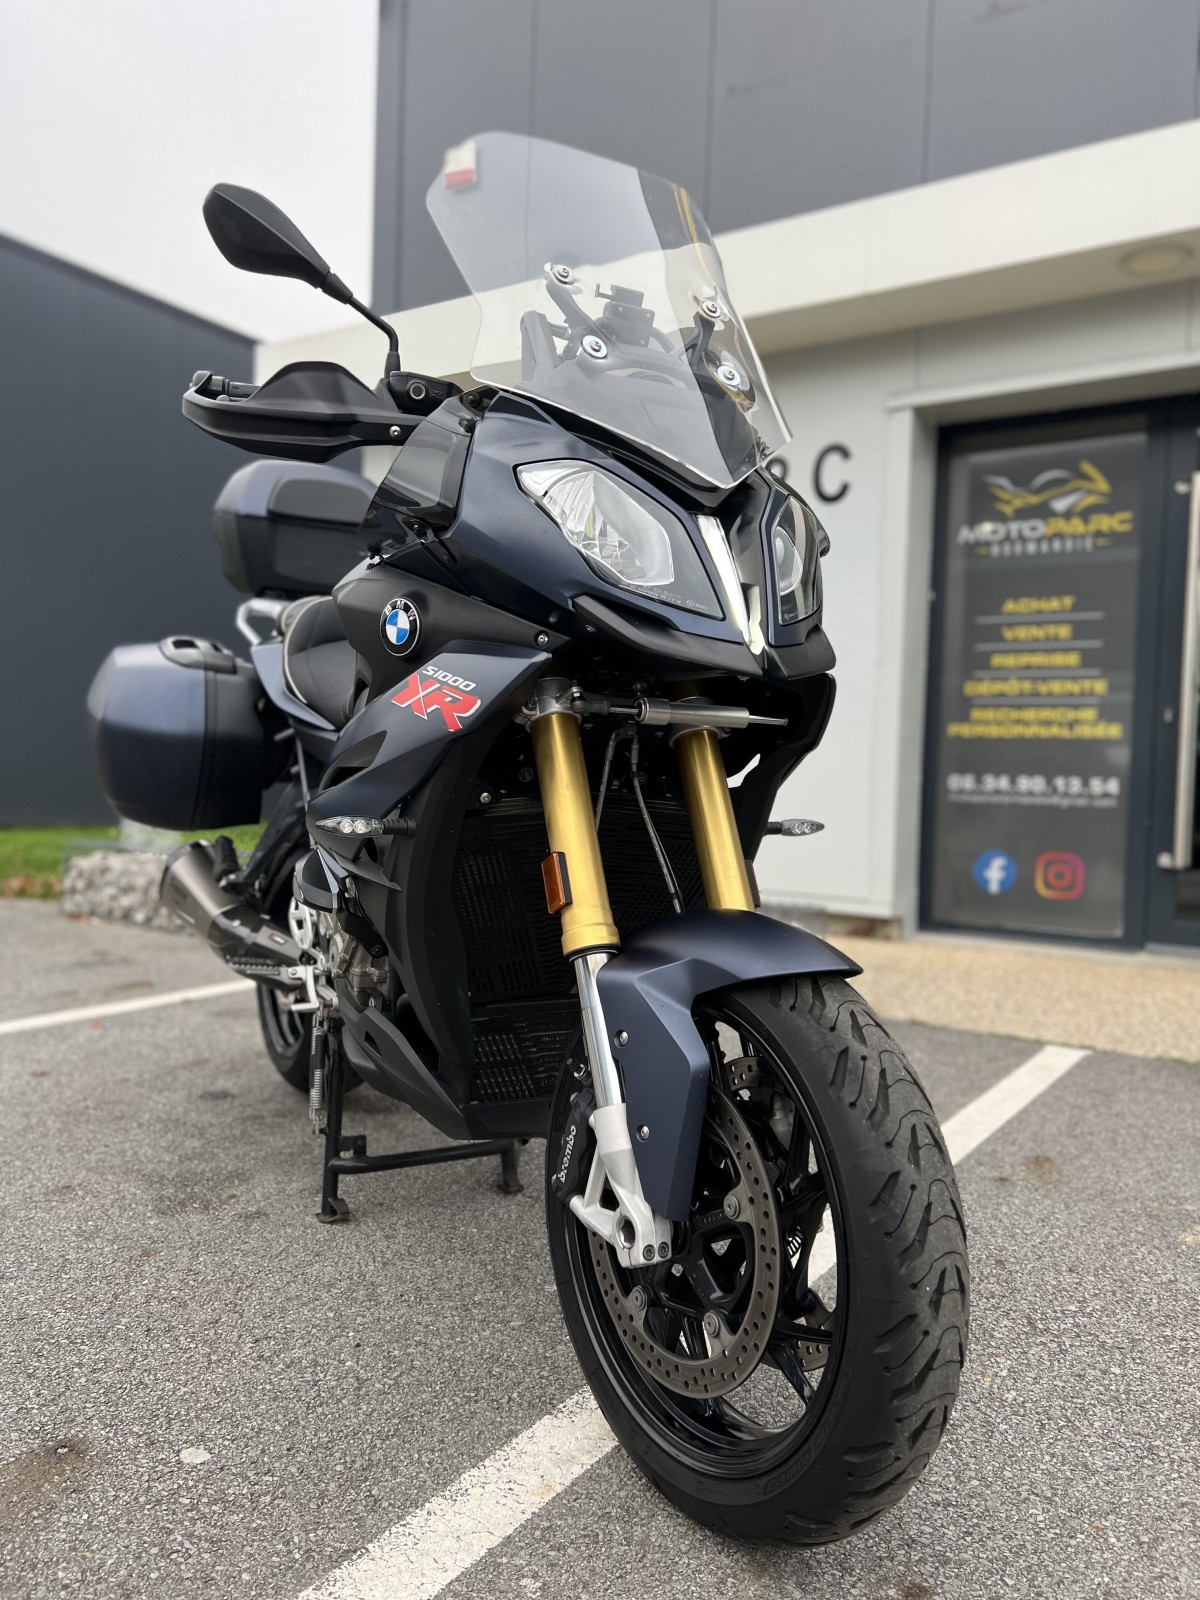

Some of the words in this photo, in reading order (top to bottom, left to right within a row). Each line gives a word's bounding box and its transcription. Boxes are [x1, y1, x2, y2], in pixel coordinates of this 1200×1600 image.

[956, 511, 1133, 545] MOTOPARC
[385, 600, 416, 621] BMW
[1001, 595, 1076, 614] ACHAT
[1000, 623, 1073, 641] VENTE
[990, 650, 1081, 668] REPRISE
[423, 665, 477, 692] S1000
[391, 673, 481, 732] XR
[969, 707, 1099, 722] RECHERCHE
[557, 1125, 577, 1183] brembo
